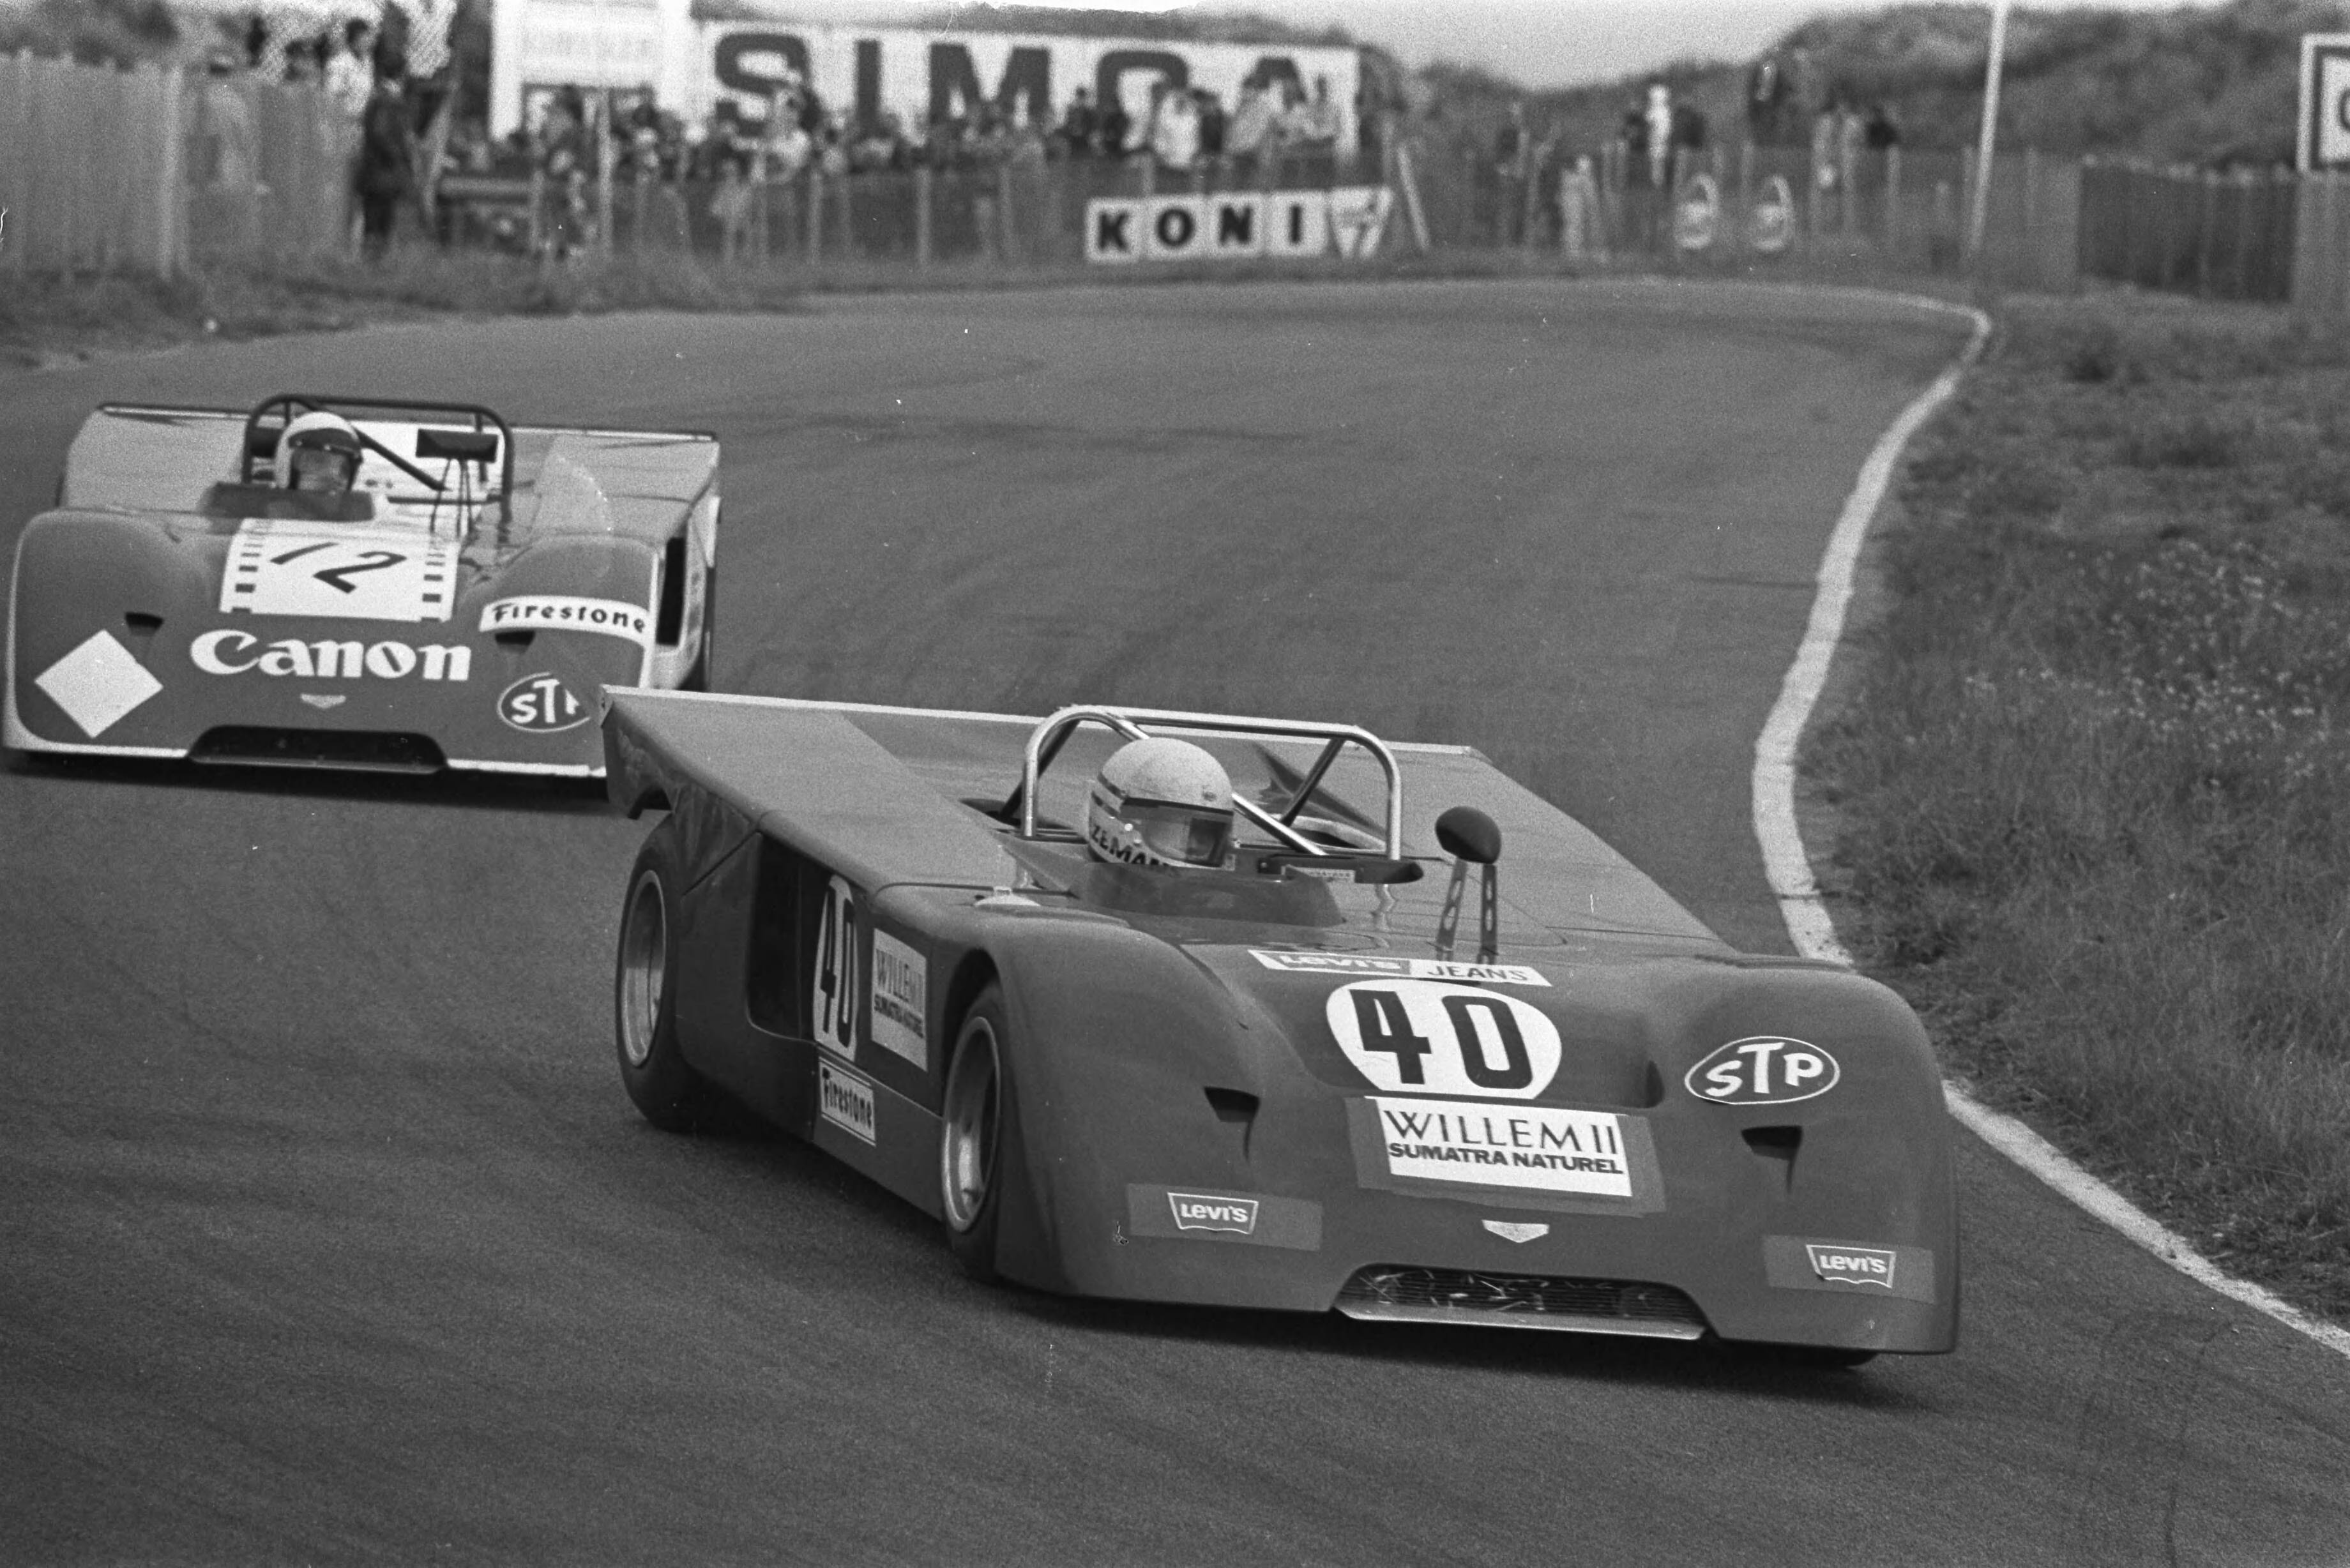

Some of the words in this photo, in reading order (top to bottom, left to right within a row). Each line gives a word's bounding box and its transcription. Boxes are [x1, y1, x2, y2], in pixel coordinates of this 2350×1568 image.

[1096, 204, 1303, 252] KONI
[270, 541, 407, 594] 12
[492, 602, 646, 634] Firestone
[190, 629, 472, 682] Canon
[820, 885, 856, 1048] 40
[1428, 965, 1528, 981] JEANS
[1349, 989, 1533, 1090] 40
[1704, 1042, 1824, 1097] STP
[822, 1067, 872, 1130] Firestone
[1384, 1110, 1582, 1152] WILLEM
[1388, 1142, 1506, 1166] SUMATRA
[1512, 1152, 1623, 1175] NATUREL
